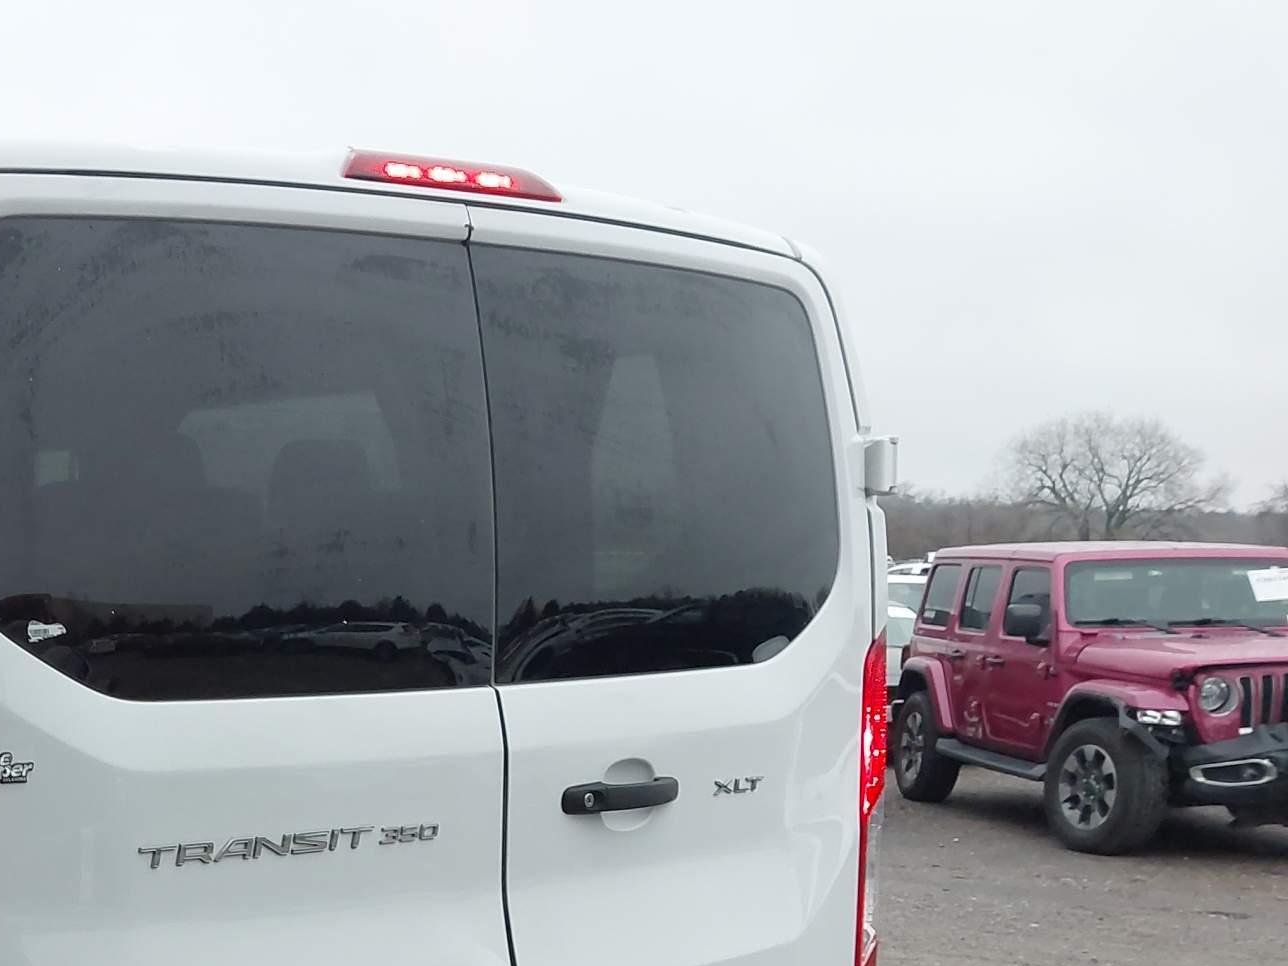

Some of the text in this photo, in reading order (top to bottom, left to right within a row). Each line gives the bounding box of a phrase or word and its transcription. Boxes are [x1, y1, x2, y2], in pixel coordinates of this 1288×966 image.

[712, 776, 764, 797] XLT
[137, 823, 440, 870] TRANSIT 350
